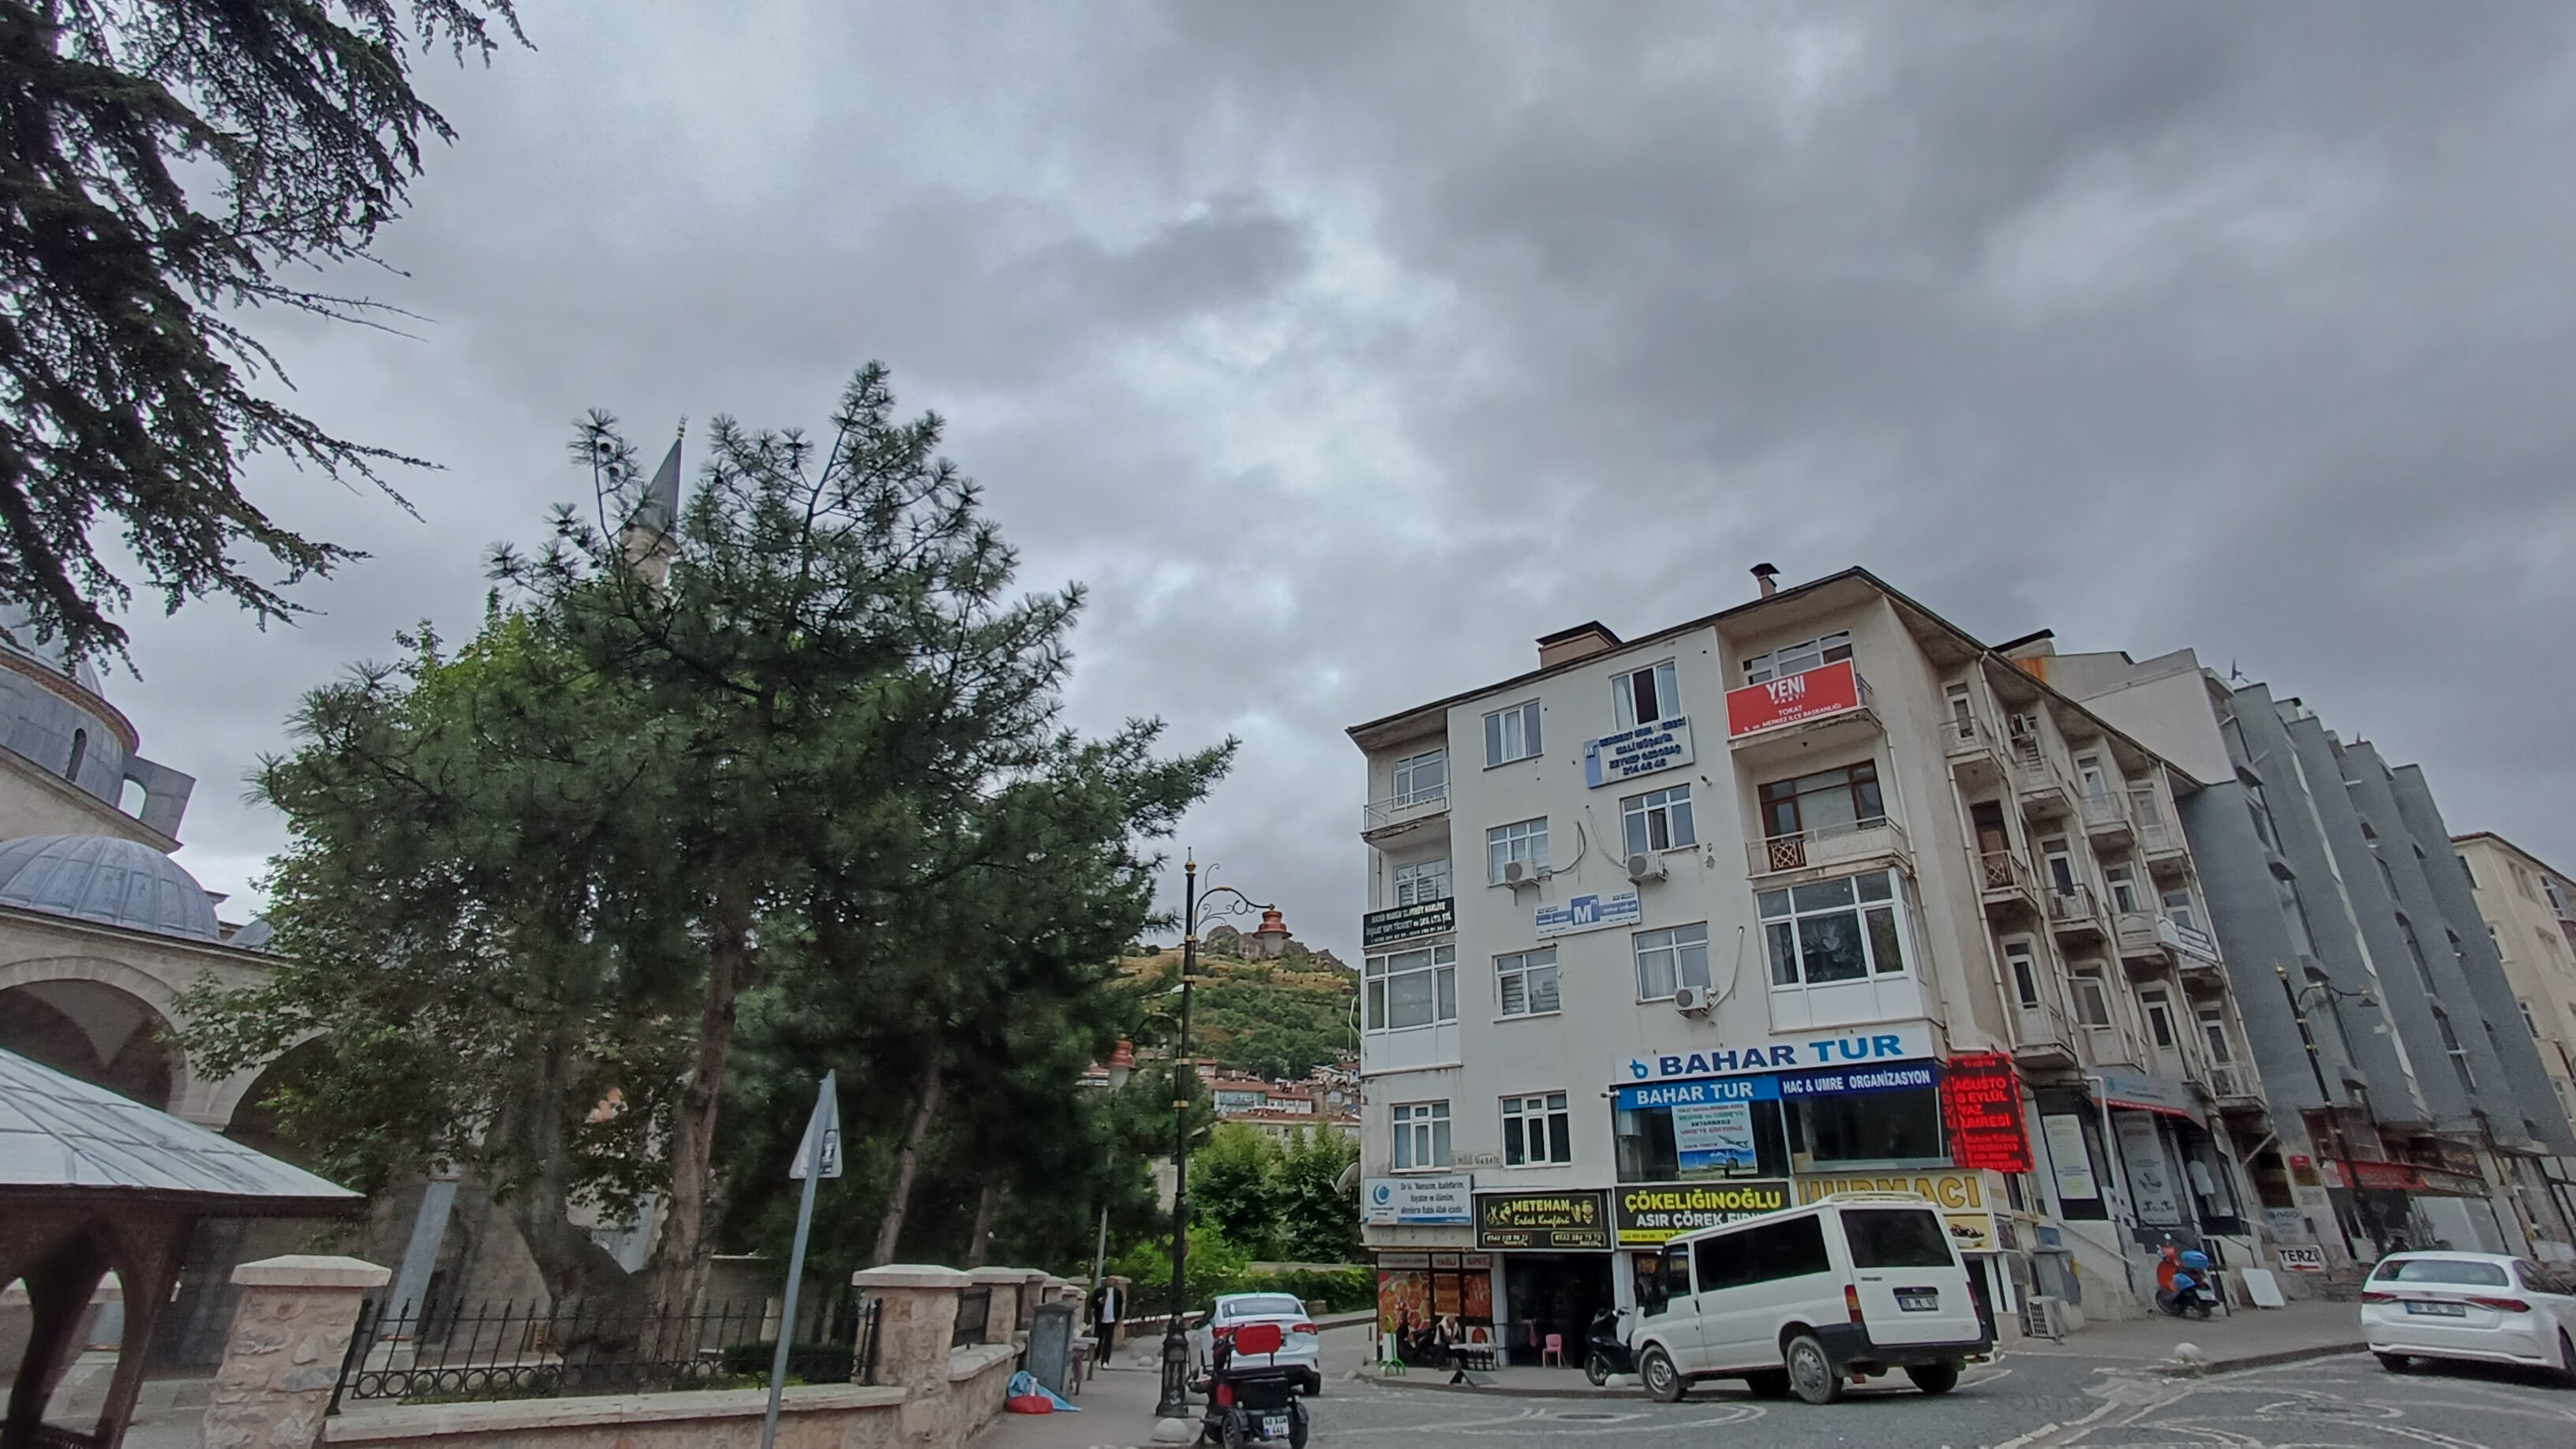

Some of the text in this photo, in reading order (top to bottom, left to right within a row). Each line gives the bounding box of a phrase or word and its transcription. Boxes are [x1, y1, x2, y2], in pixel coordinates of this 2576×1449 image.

[1778, 705, 1803, 716] TOKAT
[1762, 717, 1788, 727] MERKEZ
[1660, 1034, 1904, 1076] BAHAR TUR
[1783, 1069, 1930, 1095] HAC & UMRE ORGANİZASYON
[1637, 1081, 1754, 1105] BAHAR TUR
[1968, 1088, 2009, 1103] EYLÜL
[1958, 1104, 1983, 1115] YAZ
[1512, 1199, 1570, 1212] METEHAN
[1636, 1214, 1669, 1227] ASIR
[1673, 1210, 1723, 1229] ÇÖREK
